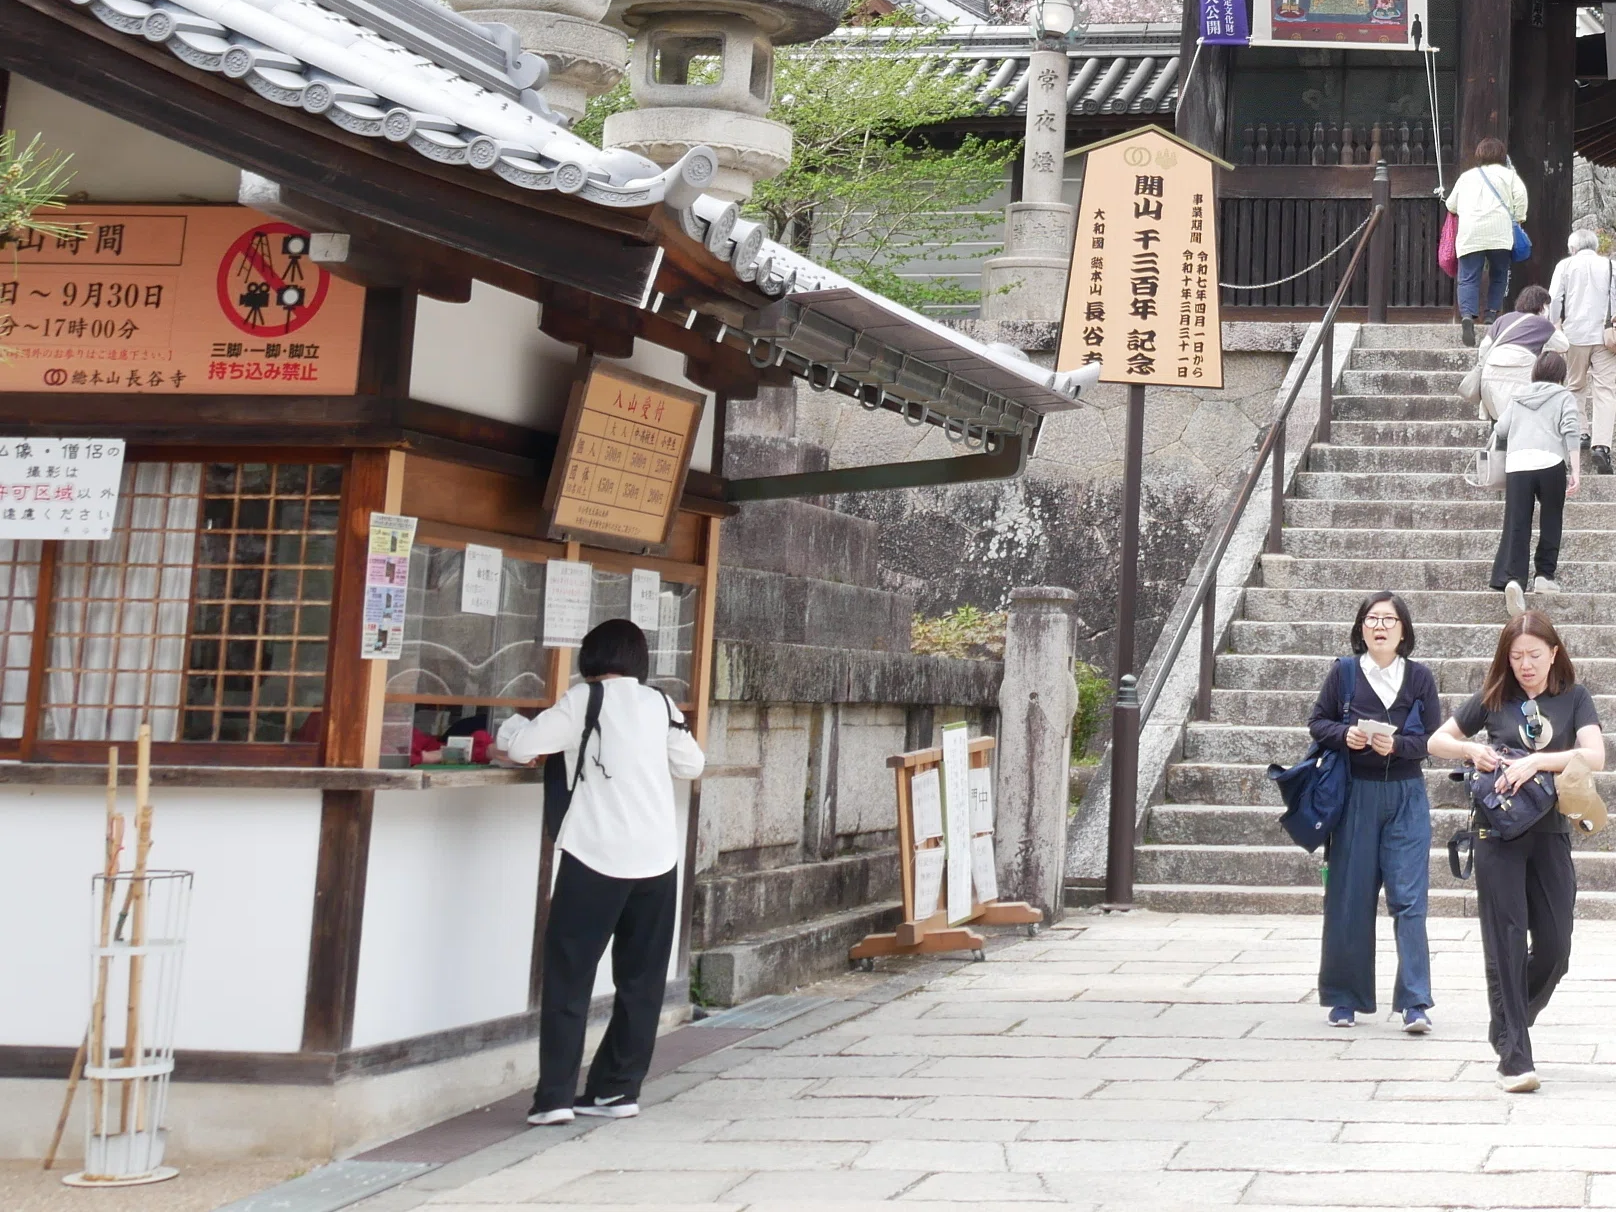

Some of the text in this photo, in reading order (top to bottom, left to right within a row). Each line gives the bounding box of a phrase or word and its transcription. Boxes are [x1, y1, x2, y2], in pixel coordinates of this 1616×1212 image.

[1032, 69, 1058, 174] 常夜燈
[1190, 193, 1204, 245] 事業期間
[1177, 249, 1194, 378] 令和十年三月三十一日
[1192, 250, 1208, 378] 令和七年四月一日から
[208, 361, 318, 382] 持ち込み禁止
[210, 342, 320, 359] 三脚・一脚・脚立
[613, 389, 666, 423] 入山受付
[26, 466, 78, 478] 撮影は
